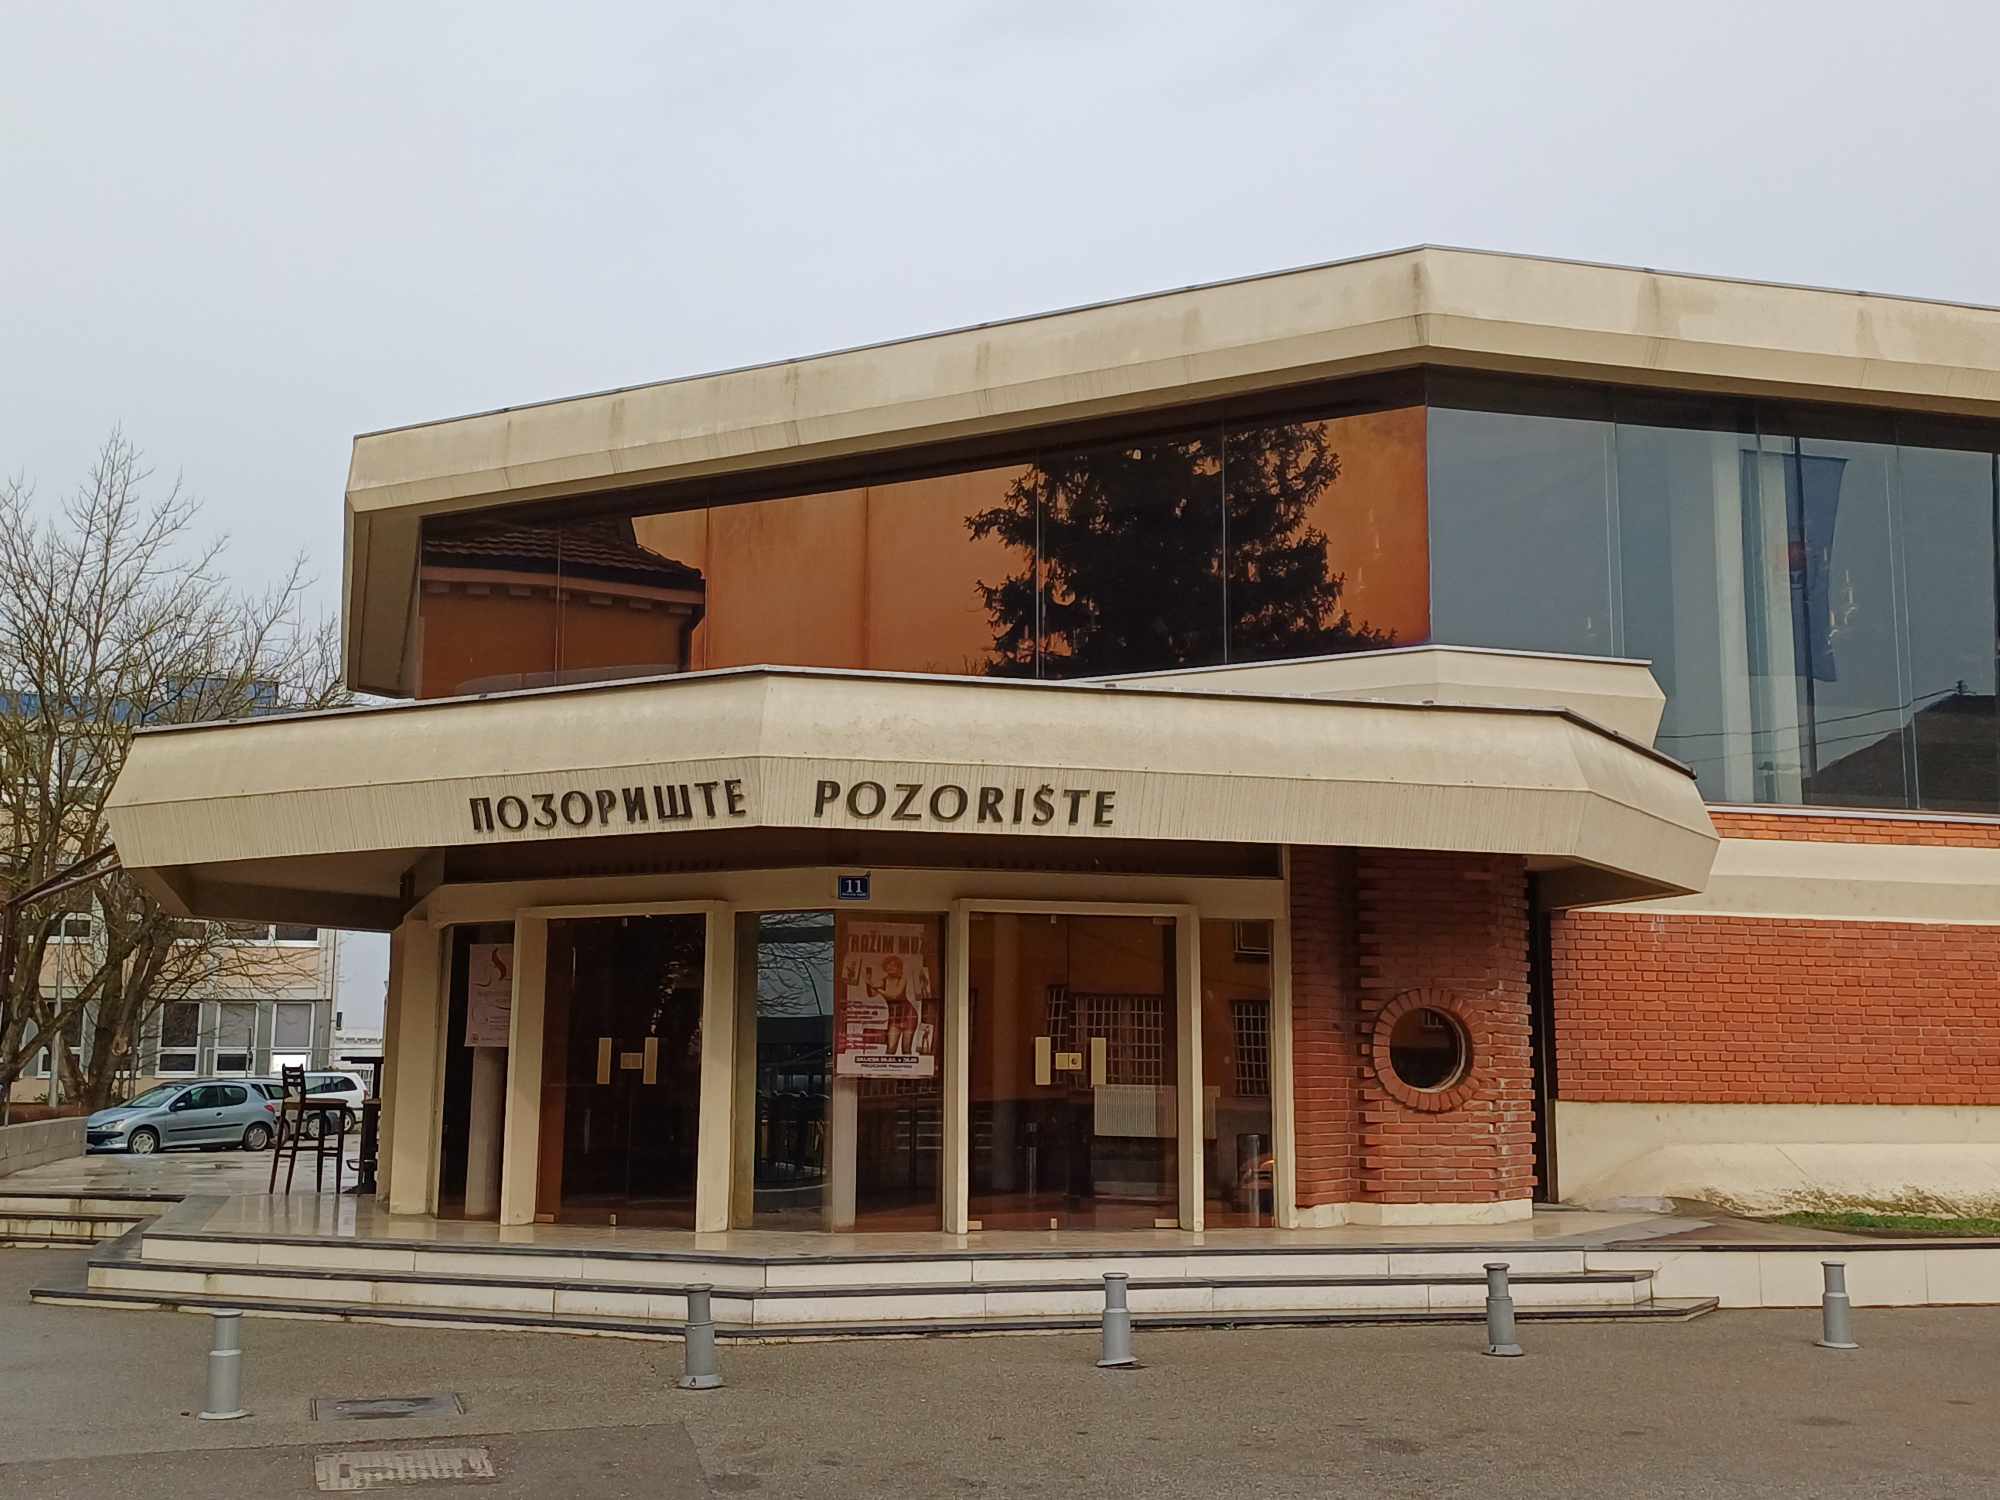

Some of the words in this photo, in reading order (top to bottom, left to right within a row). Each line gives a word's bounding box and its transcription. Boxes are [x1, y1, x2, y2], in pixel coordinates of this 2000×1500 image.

[468, 778, 747, 833] ПОЗОРИШТЕ
[813, 780, 1116, 827] POZORIŠTE
[845, 879, 863, 893] 11
[847, 930, 895, 953] RAŽIM
